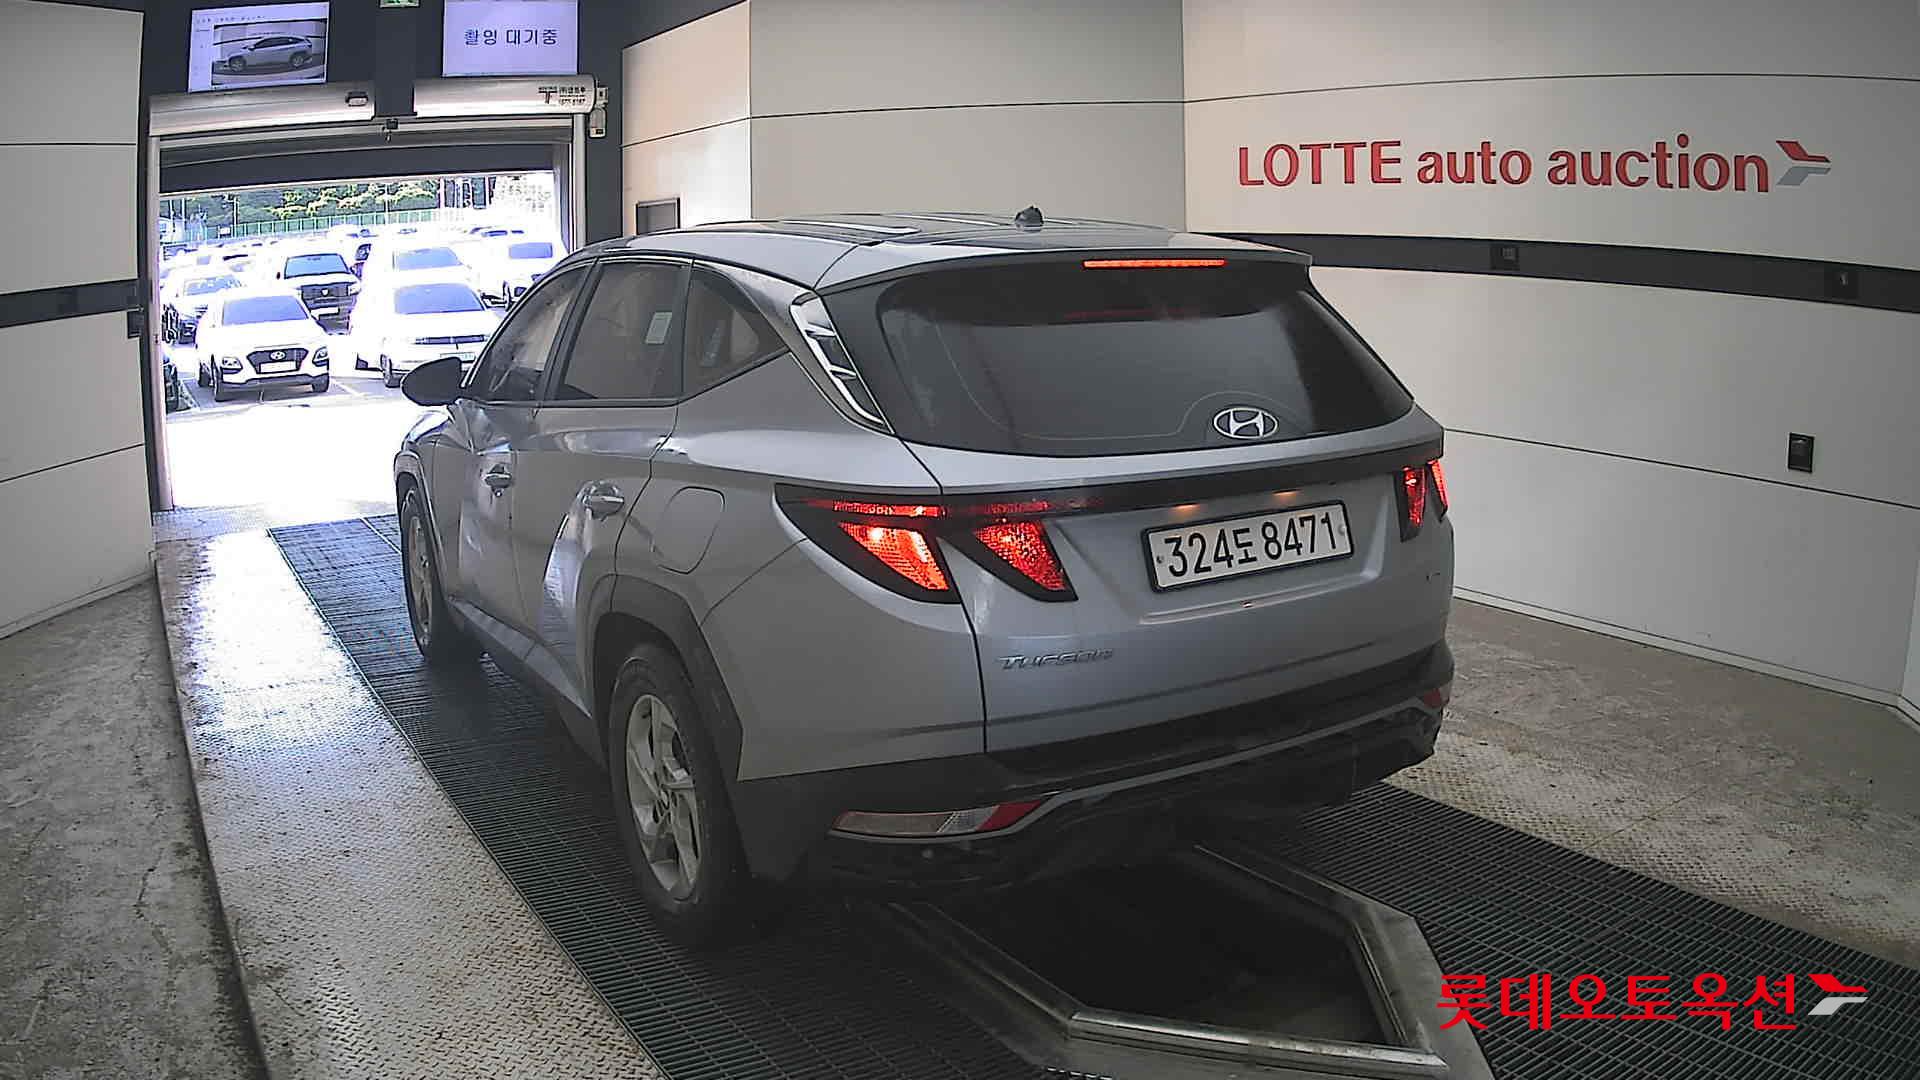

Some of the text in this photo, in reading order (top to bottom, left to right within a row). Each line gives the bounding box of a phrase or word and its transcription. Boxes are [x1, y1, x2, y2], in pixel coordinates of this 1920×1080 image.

[506, 29, 558, 46] 대기중
[1239, 134, 1769, 193] LOTTE auto auction
[1164, 511, 1337, 577] 324도 8471
